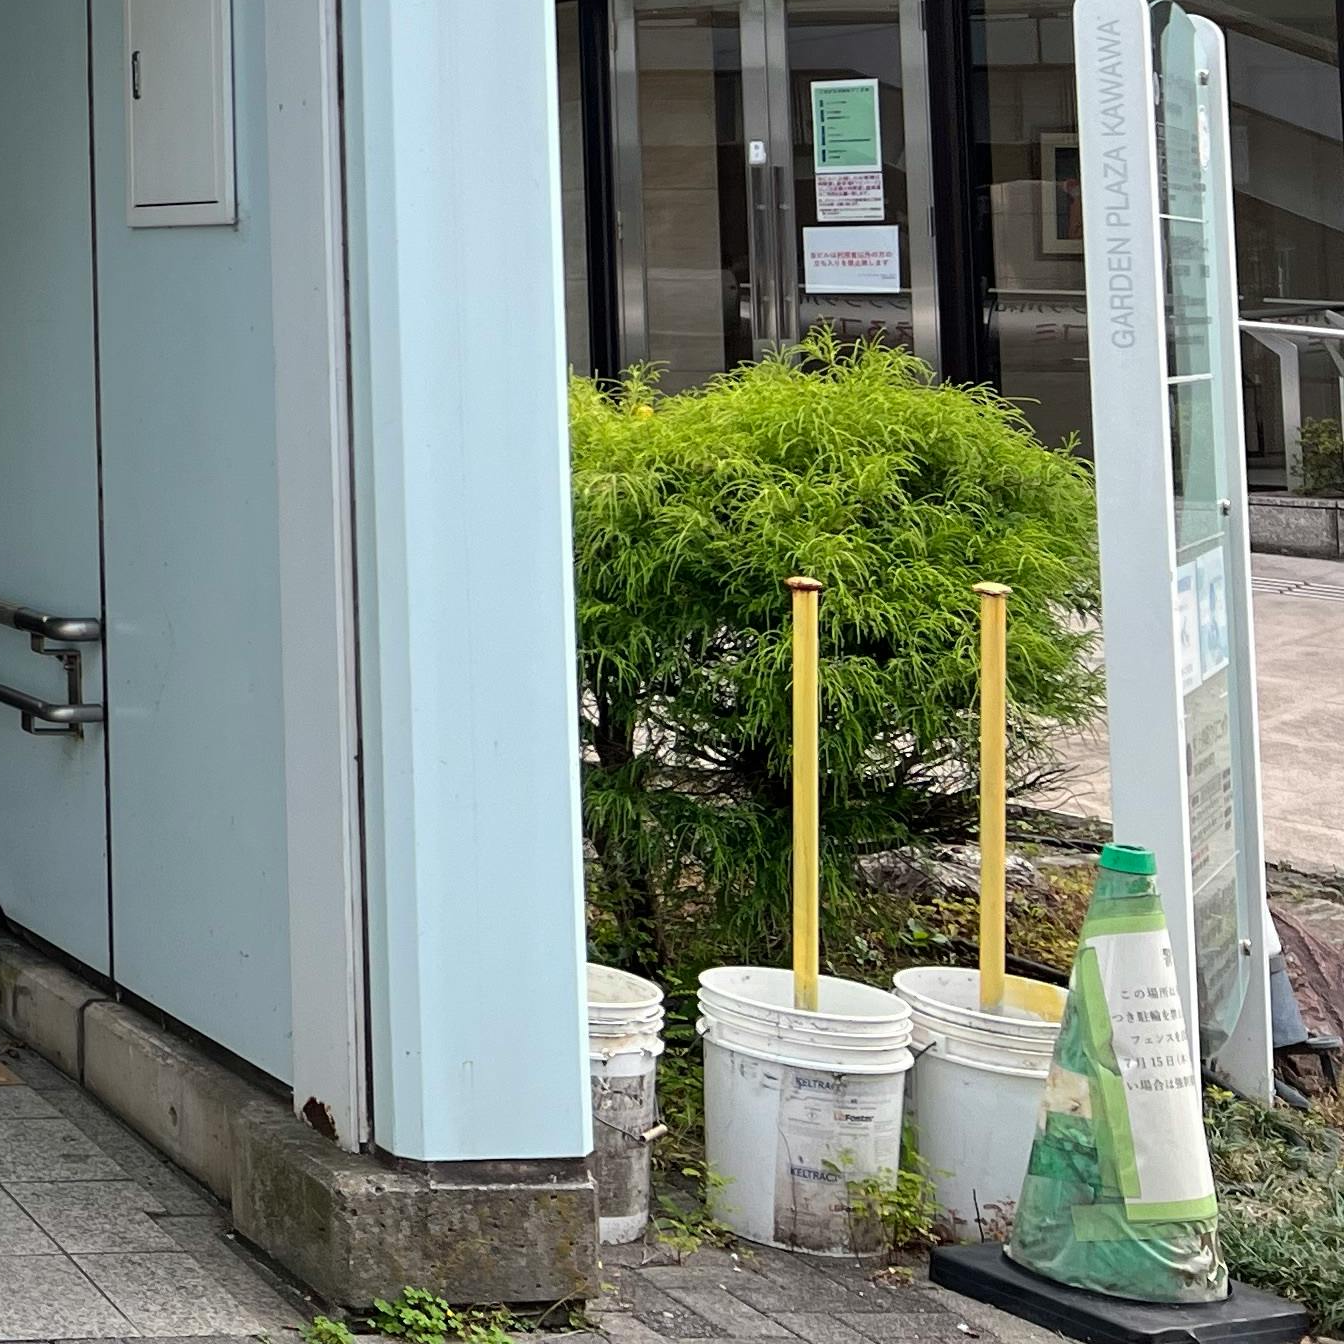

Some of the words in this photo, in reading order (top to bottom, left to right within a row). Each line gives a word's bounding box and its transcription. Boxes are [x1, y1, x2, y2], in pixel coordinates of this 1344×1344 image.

[1096, 19, 1127, 137] KAWAWA
[1103, 145, 1130, 228] PLAZA
[1106, 237, 1136, 350] GARDEN
